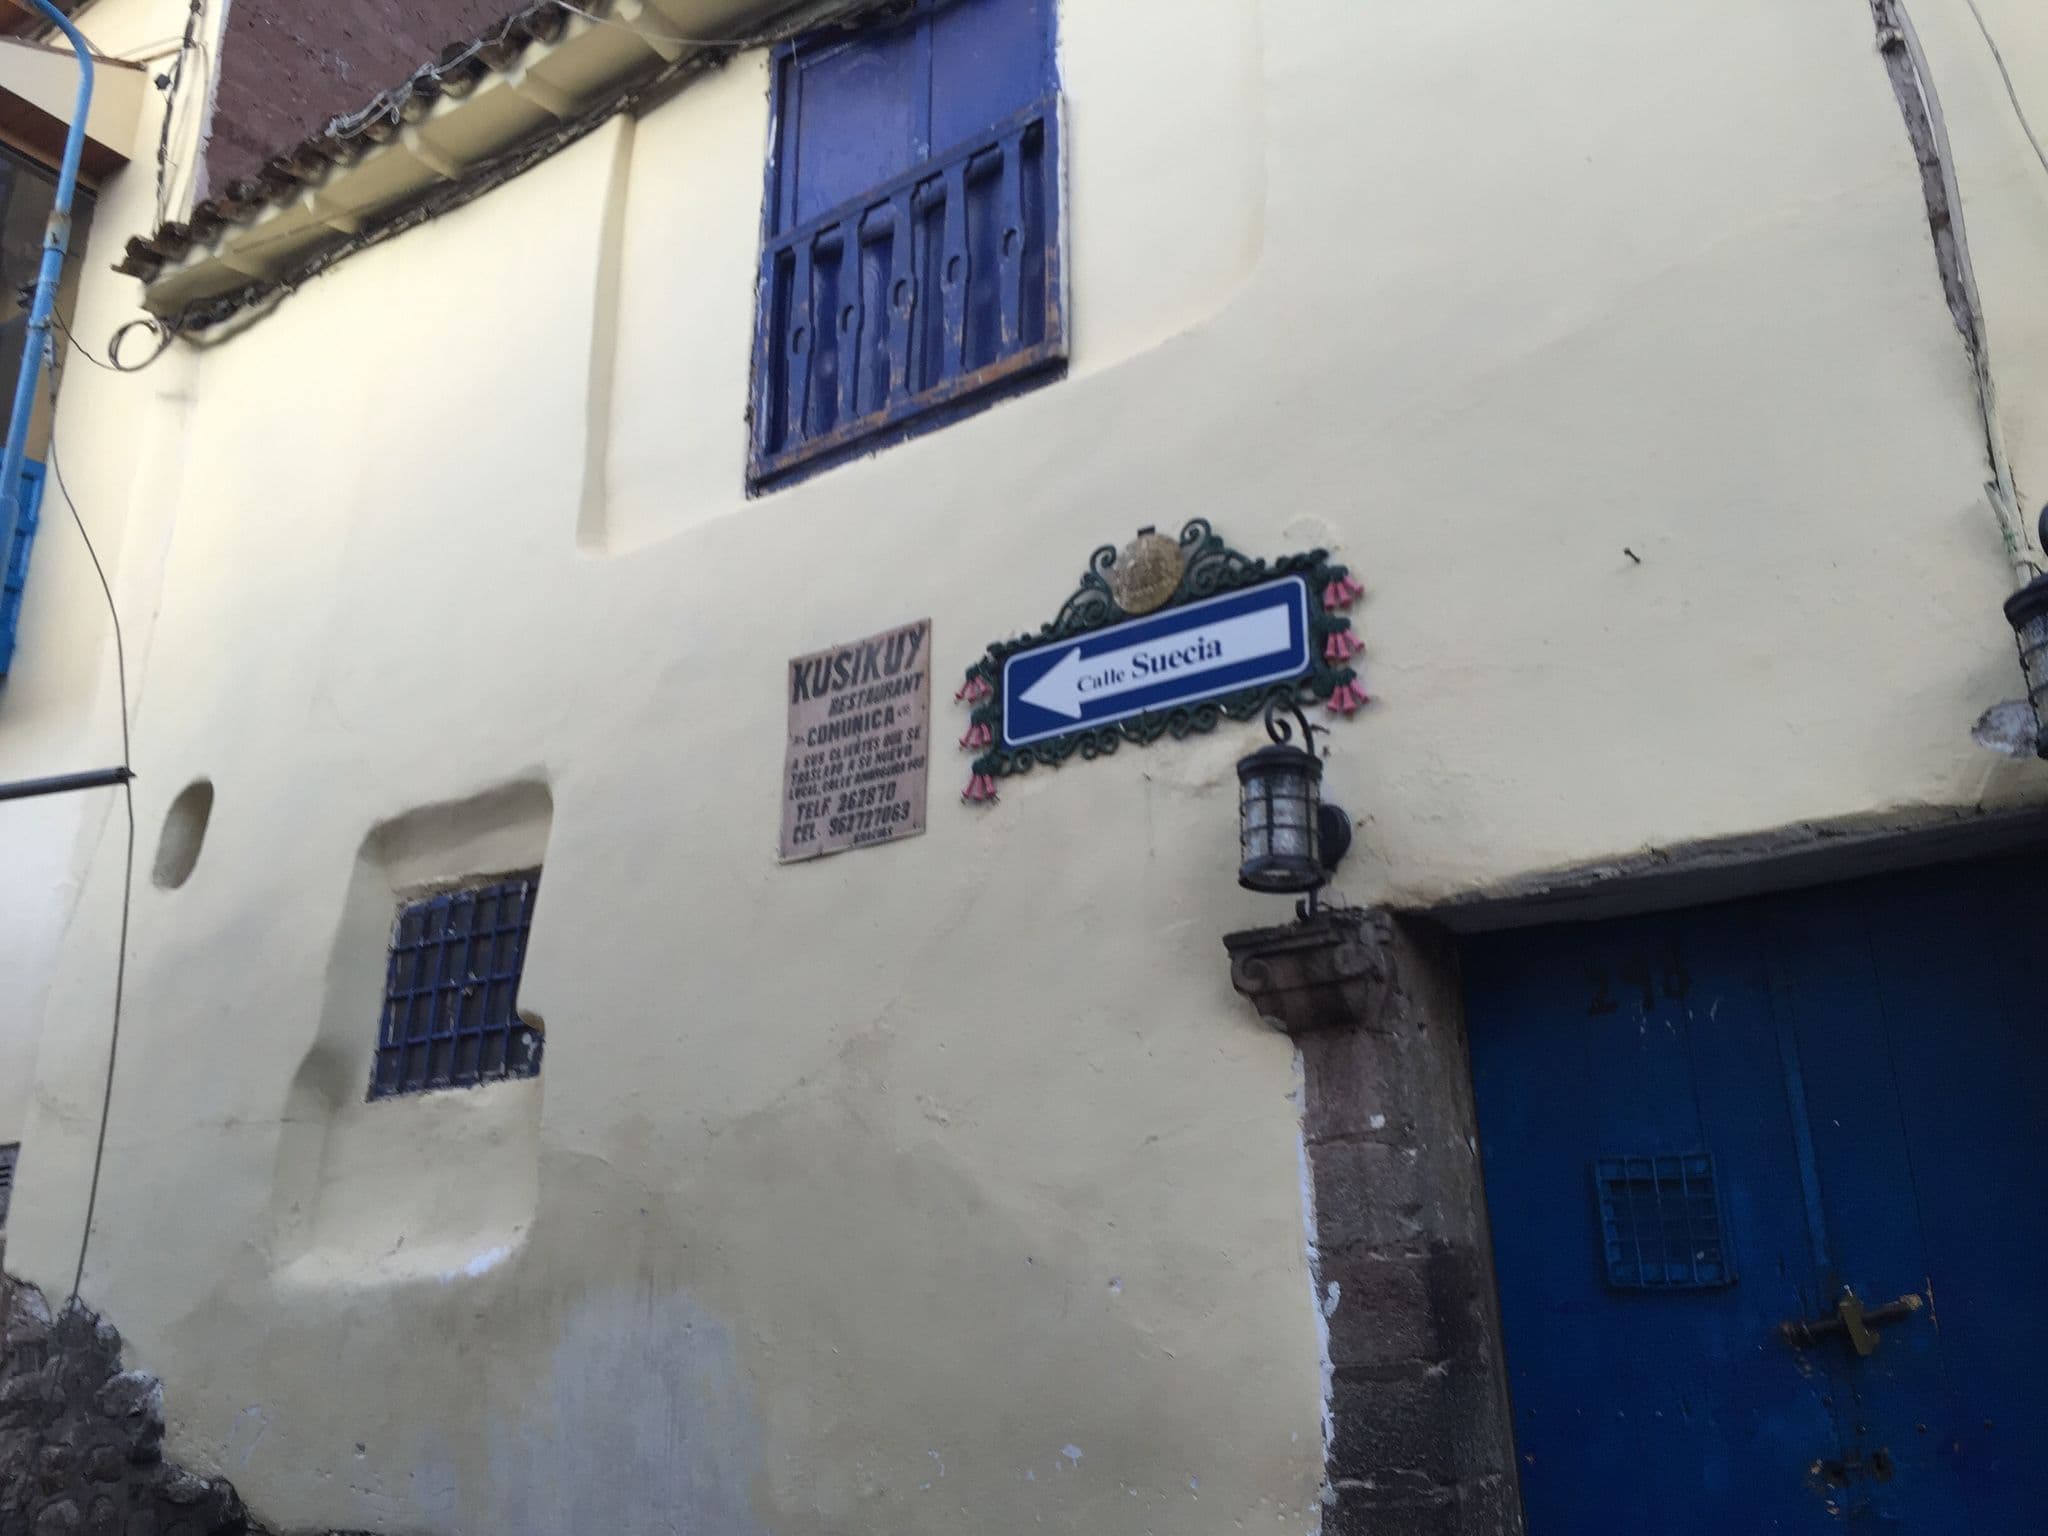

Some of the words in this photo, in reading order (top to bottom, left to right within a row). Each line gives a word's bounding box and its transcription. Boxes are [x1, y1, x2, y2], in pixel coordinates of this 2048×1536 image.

[792, 625, 925, 703] KUSIKUY
[1077, 669, 1126, 693] Calle
[1131, 637, 1223, 680] Suecia
[808, 707, 894, 746] COMUNICA
